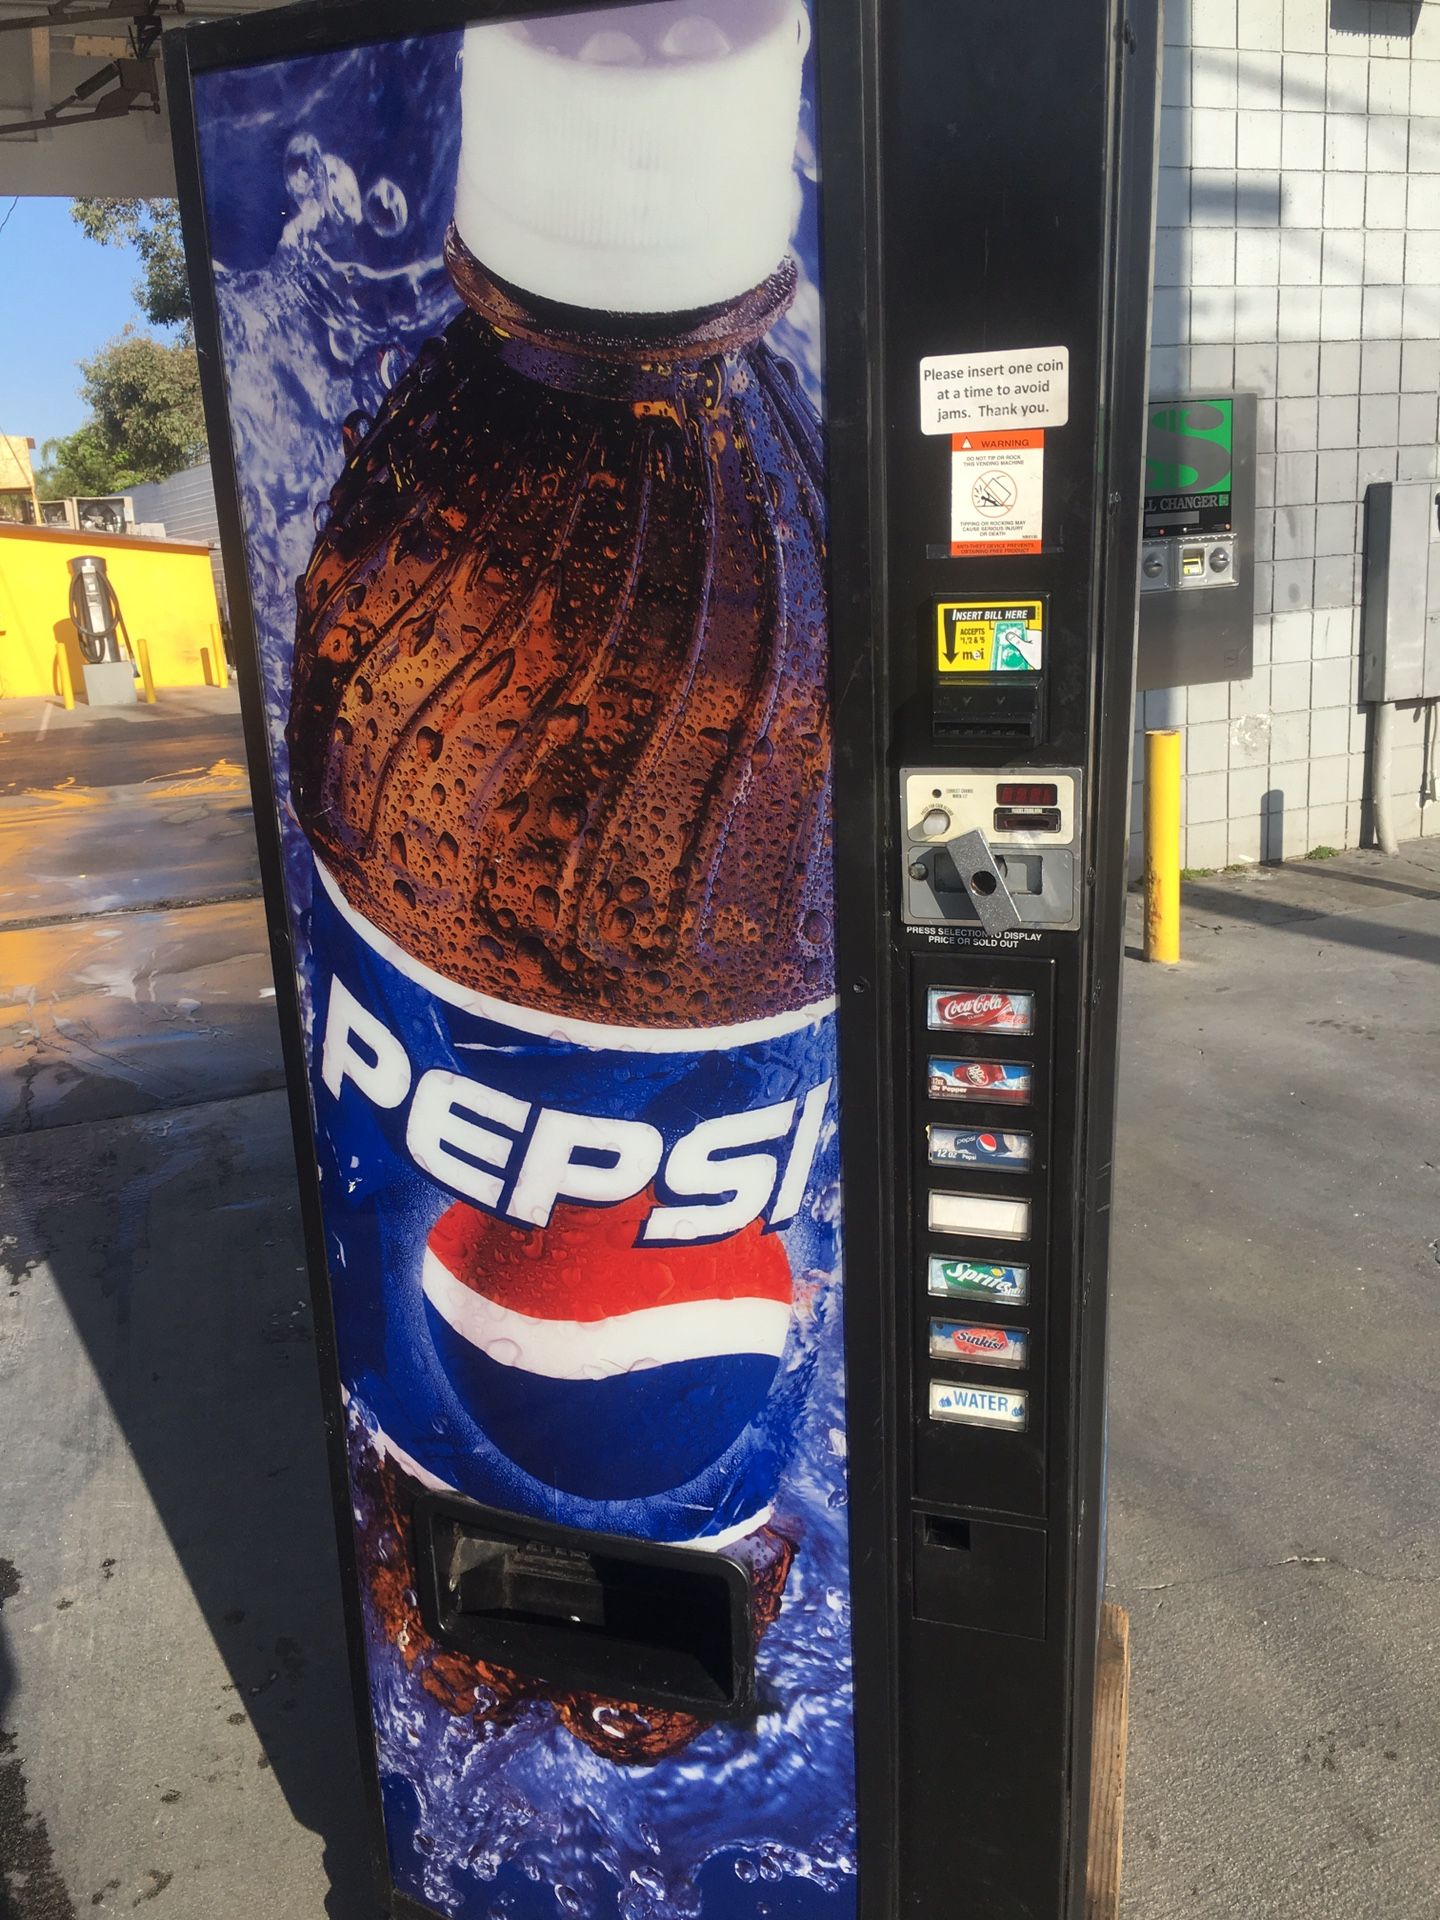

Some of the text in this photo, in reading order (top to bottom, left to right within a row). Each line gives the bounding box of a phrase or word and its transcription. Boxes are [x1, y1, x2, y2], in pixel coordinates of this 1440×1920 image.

[924, 360, 1064, 380] Please insert one coin
[937, 380, 1050, 400] at a time to avoid
[937, 403, 1049, 422] jams. Thank you.
[982, 439, 1030, 448] WARNING
[1160, 495, 1218, 510] CHANGER
[952, 609, 984, 620] INSERT
[984, 610, 1004, 620] BILL
[1004, 610, 1028, 619] HERE
[962, 648, 984, 660] mei
[906, 926, 936, 935] PRESS
[938, 927, 988, 938] SELECTION
[1004, 932, 1042, 941] DISPLAY
[928, 936, 954, 944] PRICE
[973, 938, 998, 947] SOLD
[1001, 940, 1019, 948] OUT
[321, 972, 833, 1240] PEPSI
[956, 1136, 976, 1145] pepsi
[937, 1149, 946, 1158] 12
[946, 1262, 1012, 1291] Sprite
[958, 1332, 1004, 1350] Sunkist
[953, 1390, 1008, 1412] WATER
